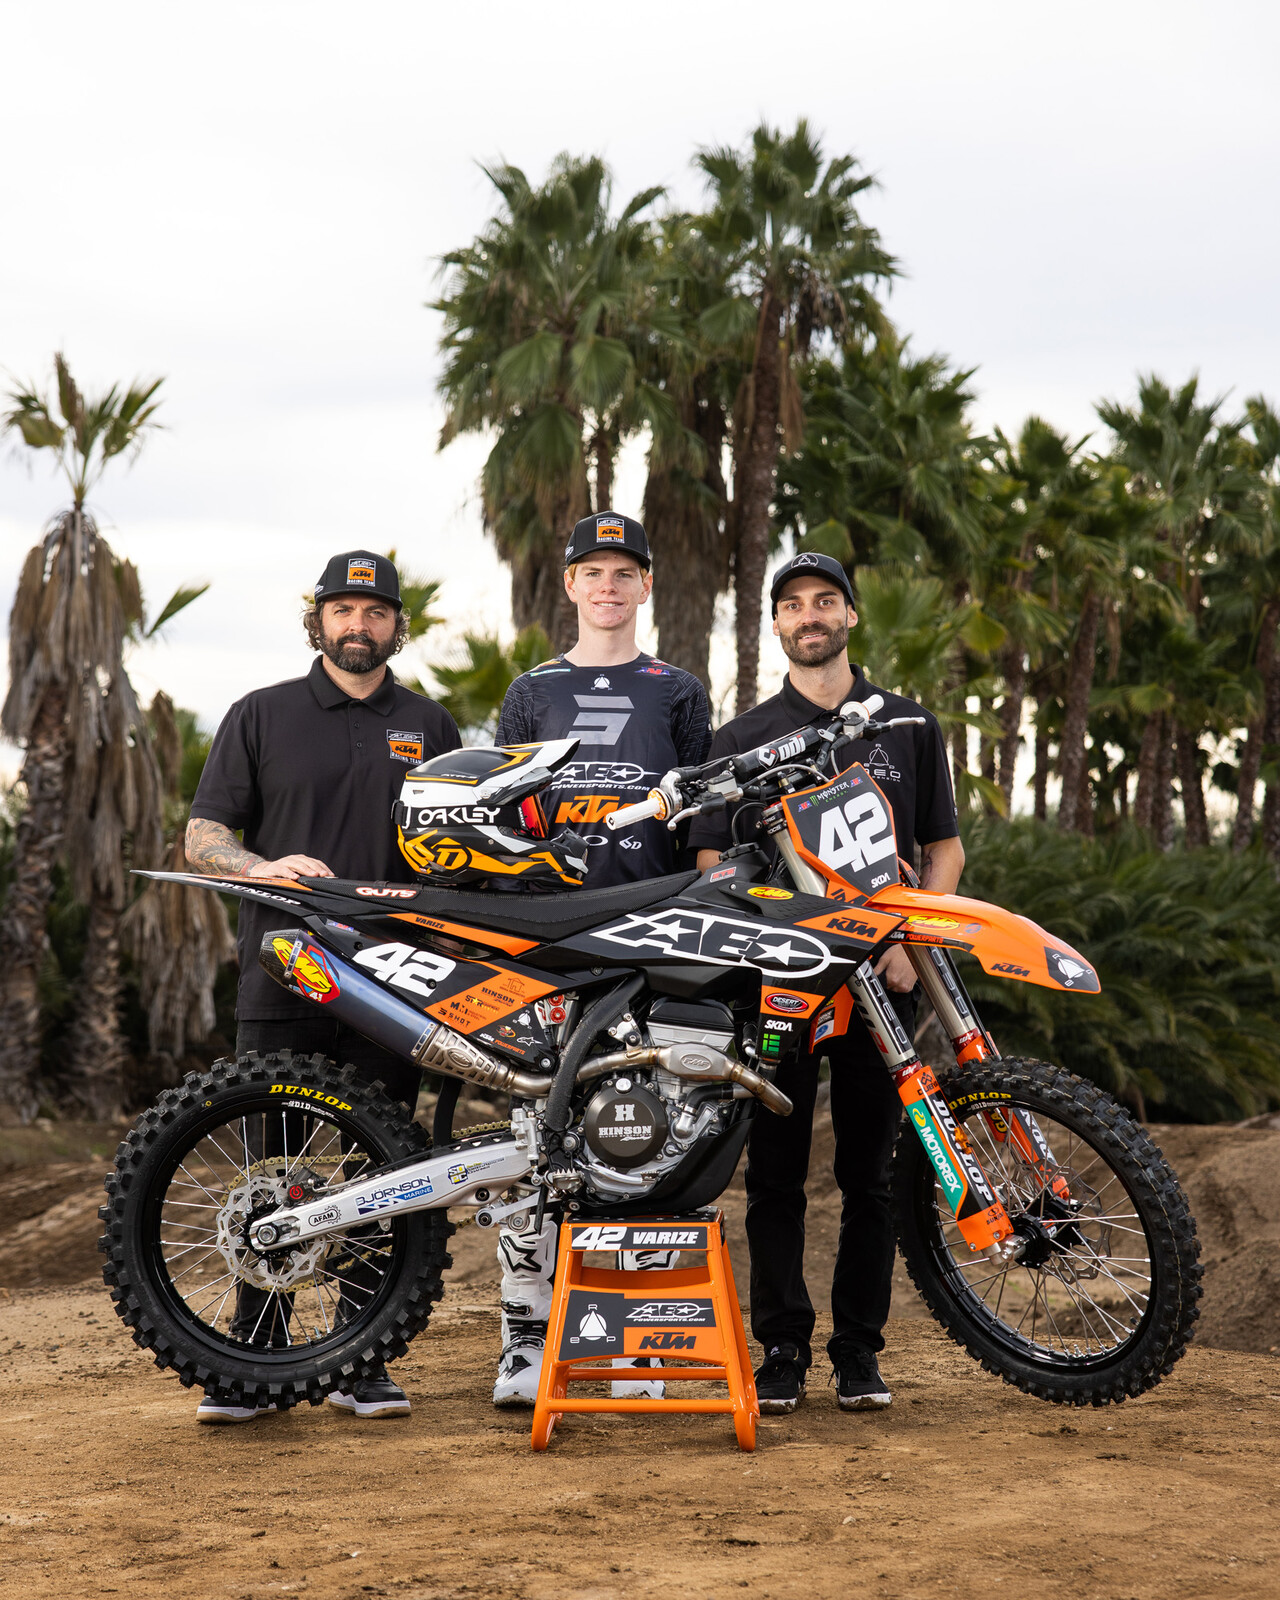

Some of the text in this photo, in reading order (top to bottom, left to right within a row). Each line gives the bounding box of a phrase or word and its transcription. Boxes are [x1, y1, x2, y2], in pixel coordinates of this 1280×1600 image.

[602, 528, 620, 536] KTM
[352, 569, 371, 578] KTM
[395, 745, 418, 755] KTM
[817, 782, 849, 800] MONSTER
[418, 807, 500, 826] OAKLEY
[818, 792, 897, 872] 42
[871, 873, 891, 888] SKDA
[220, 882, 301, 905] DUNLOP
[356, 886, 417, 898] GUTS
[415, 916, 445, 930] VARIZE
[826, 917, 878, 938] KTM
[589, 908, 840, 978] AEO
[906, 933, 943, 944] POWERPARTS
[352, 942, 456, 997] 42
[990, 962, 1031, 977] KTM
[481, 987, 515, 1004] HINSON
[772, 996, 800, 1006] DESERT
[764, 1019, 793, 1032] SKDA
[269, 1084, 353, 1112] DUNLOP
[949, 1091, 1012, 1110] DUNLOP
[614, 1104, 636, 1122] H
[598, 1125, 652, 1136] HINSON
[933, 1099, 994, 1202] DULOP
[920, 1127, 961, 1194] MOTOREX
[356, 1175, 431, 1206] BJÖRNSON
[403, 1186, 433, 1200] MARINE
[313, 1212, 334, 1224] AFAM
[571, 1227, 700, 1250] 42 VARIZE
[626, 1303, 702, 1318] AEO
[638, 1332, 697, 1350] KTM
